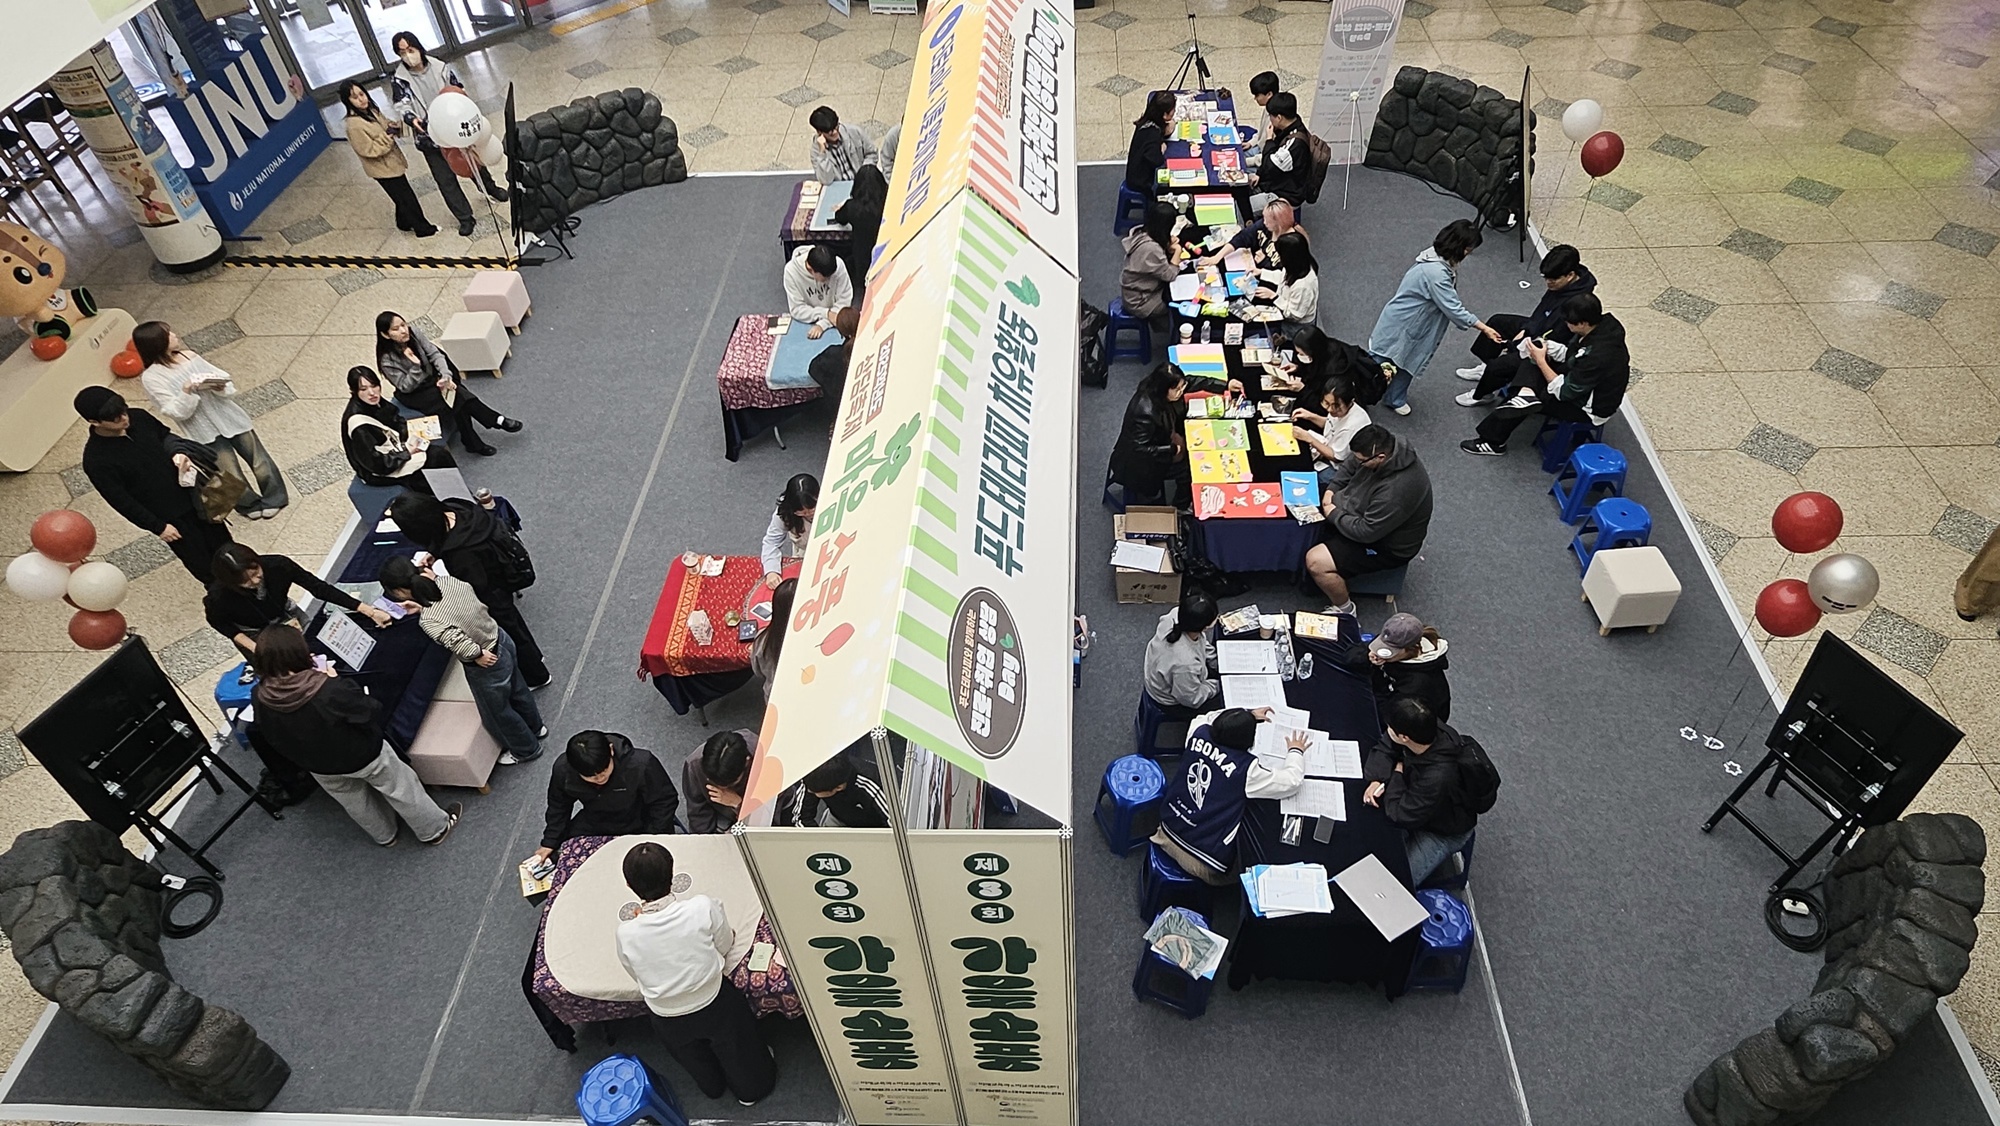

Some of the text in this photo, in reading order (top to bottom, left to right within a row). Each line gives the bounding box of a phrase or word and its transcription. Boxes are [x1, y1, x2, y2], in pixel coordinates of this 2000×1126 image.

[1025, 9, 1064, 73] Day
[184, 35, 297, 182] JNU
[1024, 53, 1058, 115] 상담
[242, 123, 316, 199] JEJU NATIONAL UNIVERSITY
[901, 175, 932, 225] 시간
[840, 354, 876, 443] 상담축제
[868, 339, 892, 417] 2025학년도
[973, 302, 1038, 577] 푸드테라피 치유활동
[793, 430, 877, 632] 마음소풍
[957, 608, 976, 709] 푸드테라피와 함께하는
[976, 600, 998, 646] 상담
[998, 651, 1019, 705] Day
[1190, 737, 1237, 778] ISOMA
